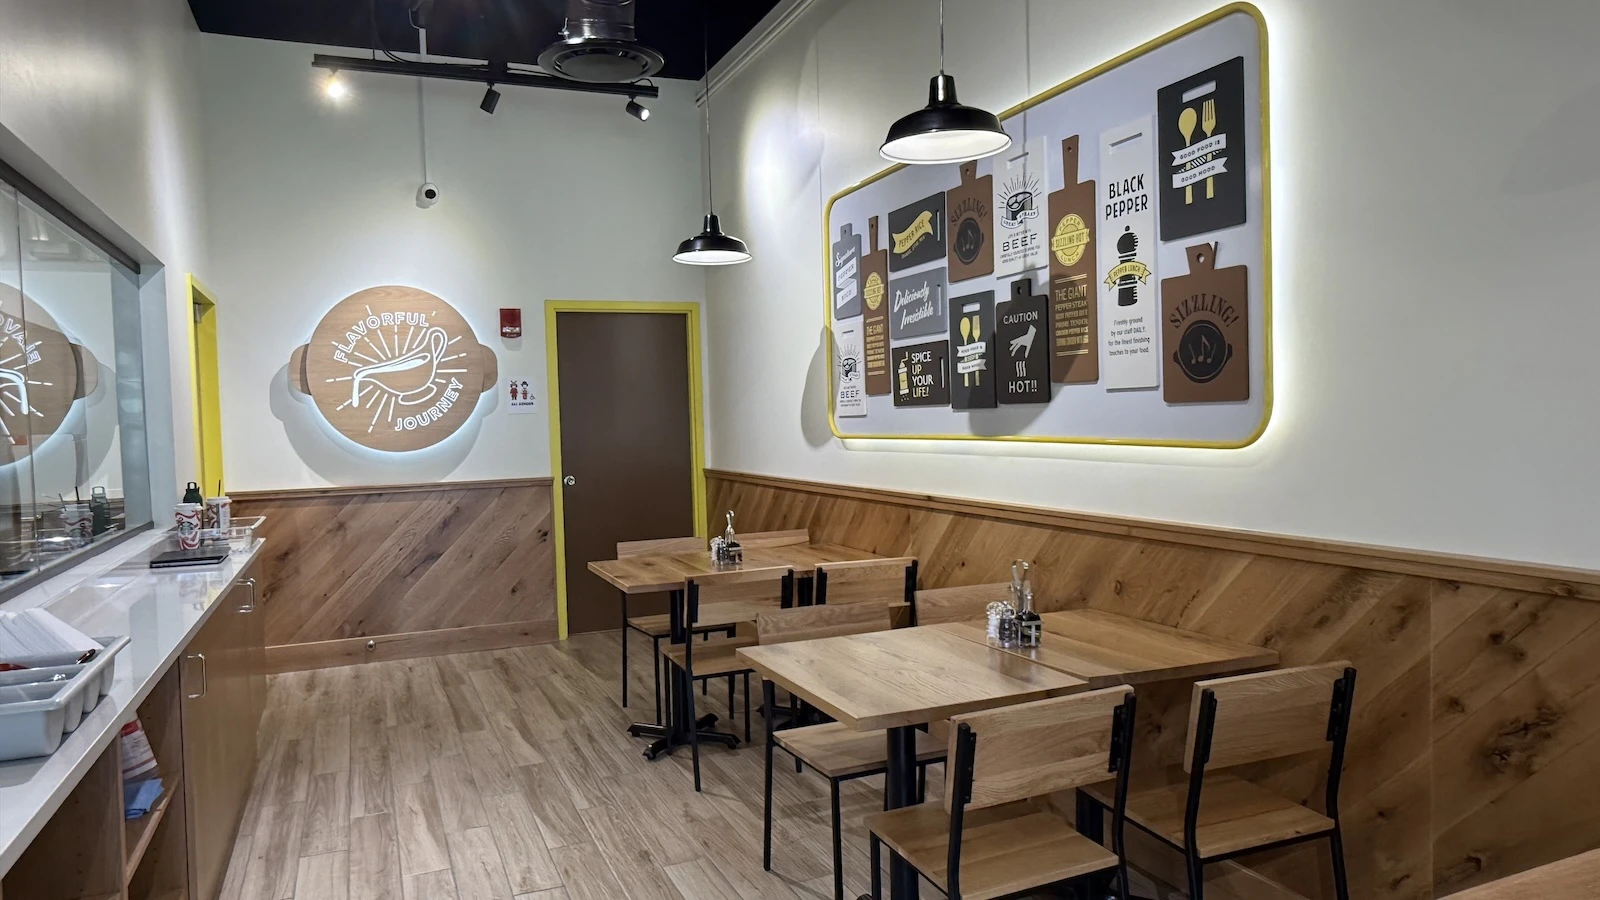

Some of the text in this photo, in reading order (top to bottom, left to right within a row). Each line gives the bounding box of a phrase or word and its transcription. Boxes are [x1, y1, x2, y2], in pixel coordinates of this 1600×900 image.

[1180, 150, 1196, 160] GOOD
[1196, 142, 1213, 153] FOOD
[1181, 165, 1216, 183] GOOD MOOD
[1109, 173, 1145, 200] BLACK
[1105, 193, 1148, 221] PEPPER
[1059, 216, 1081, 232] PEPPER
[898, 230, 914, 248] PEPPER
[914, 219, 925, 233] RICE
[1055, 234, 1075, 249] SIZZLING
[1002, 232, 1037, 252] BEEF
[1060, 251, 1080, 263] LUNCH
[1113, 264, 1141, 277] PEPPER LUNCH
[893, 280, 930, 313] Deliciously
[1055, 284, 1088, 301] THE GIANT
[1072, 300, 1088, 309] STEAK
[1169, 293, 1240, 329] SIZZLING!
[1003, 311, 1038, 325] CAUTION
[333, 312, 429, 363] FLAVORFUL
[911, 350, 932, 364] SPICE
[911, 364, 923, 375] UP
[911, 374, 934, 387] YOUR
[1008, 379, 1038, 394] HOT!!
[840, 390, 860, 399] BEEF
[912, 386, 930, 398] LIFE!
[394, 377, 464, 432] JOURNEY
